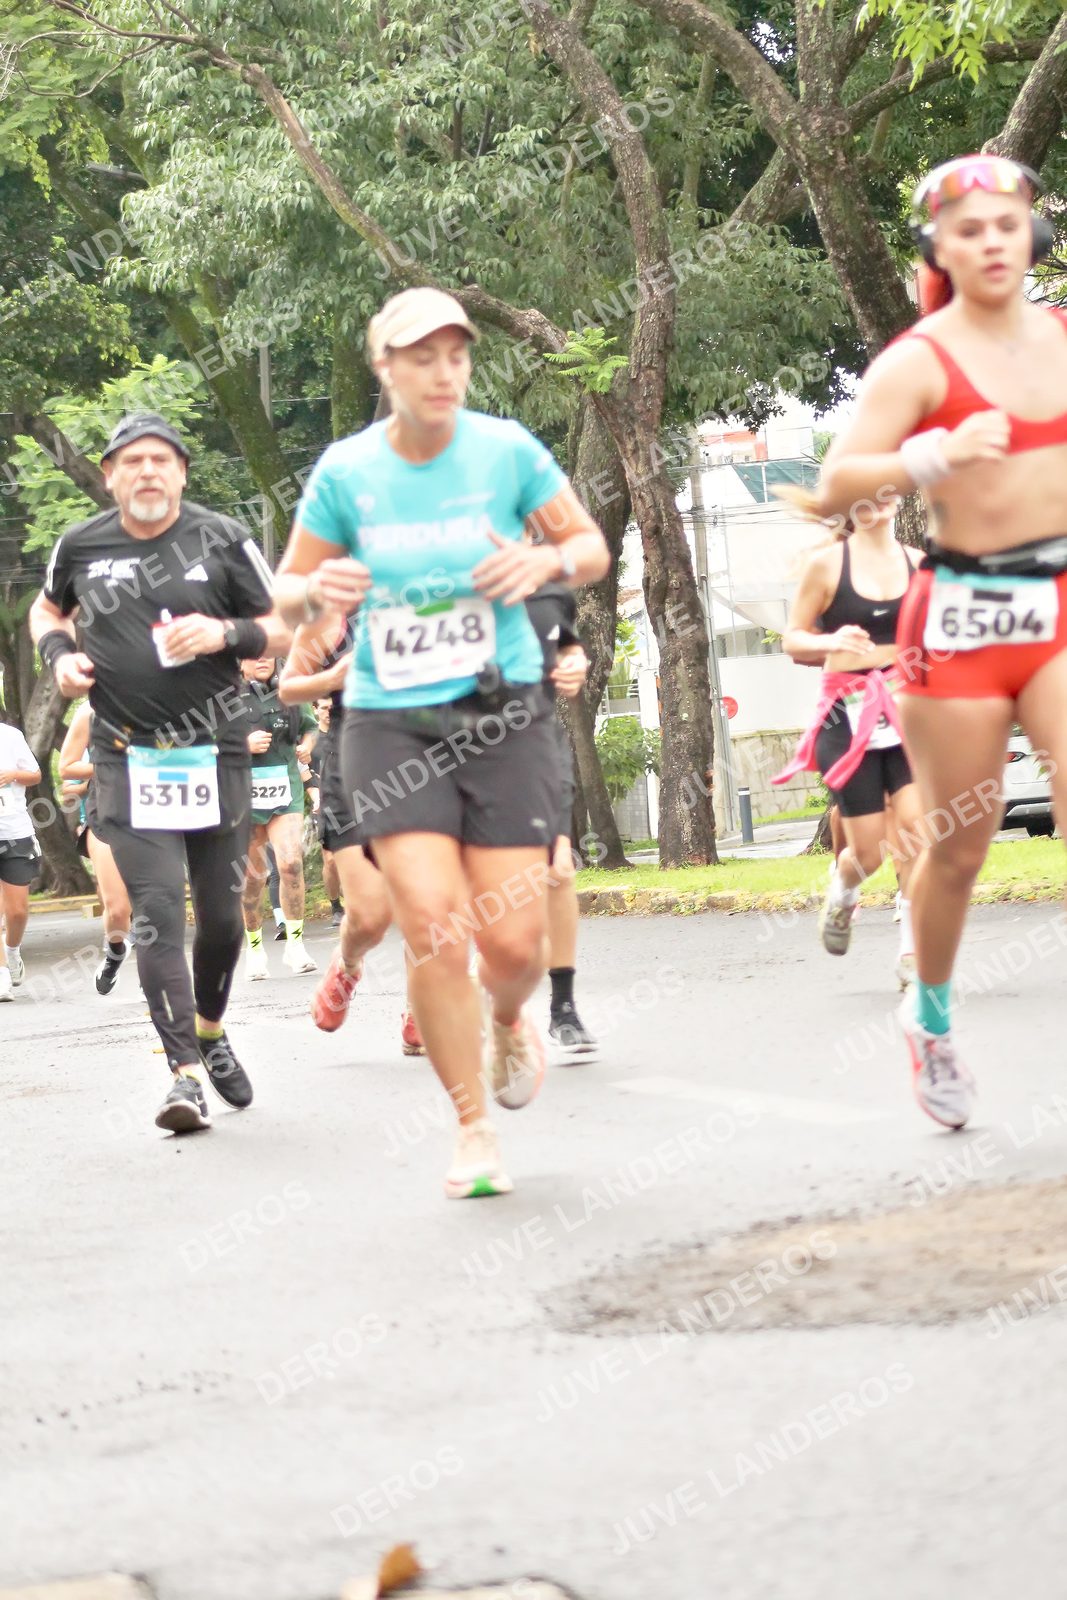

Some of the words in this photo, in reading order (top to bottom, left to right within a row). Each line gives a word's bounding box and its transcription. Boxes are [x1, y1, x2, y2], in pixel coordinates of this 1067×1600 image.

[385, 614, 485, 656] 4248
[942, 607, 1044, 638] 6504
[139, 784, 211, 806] 5319
